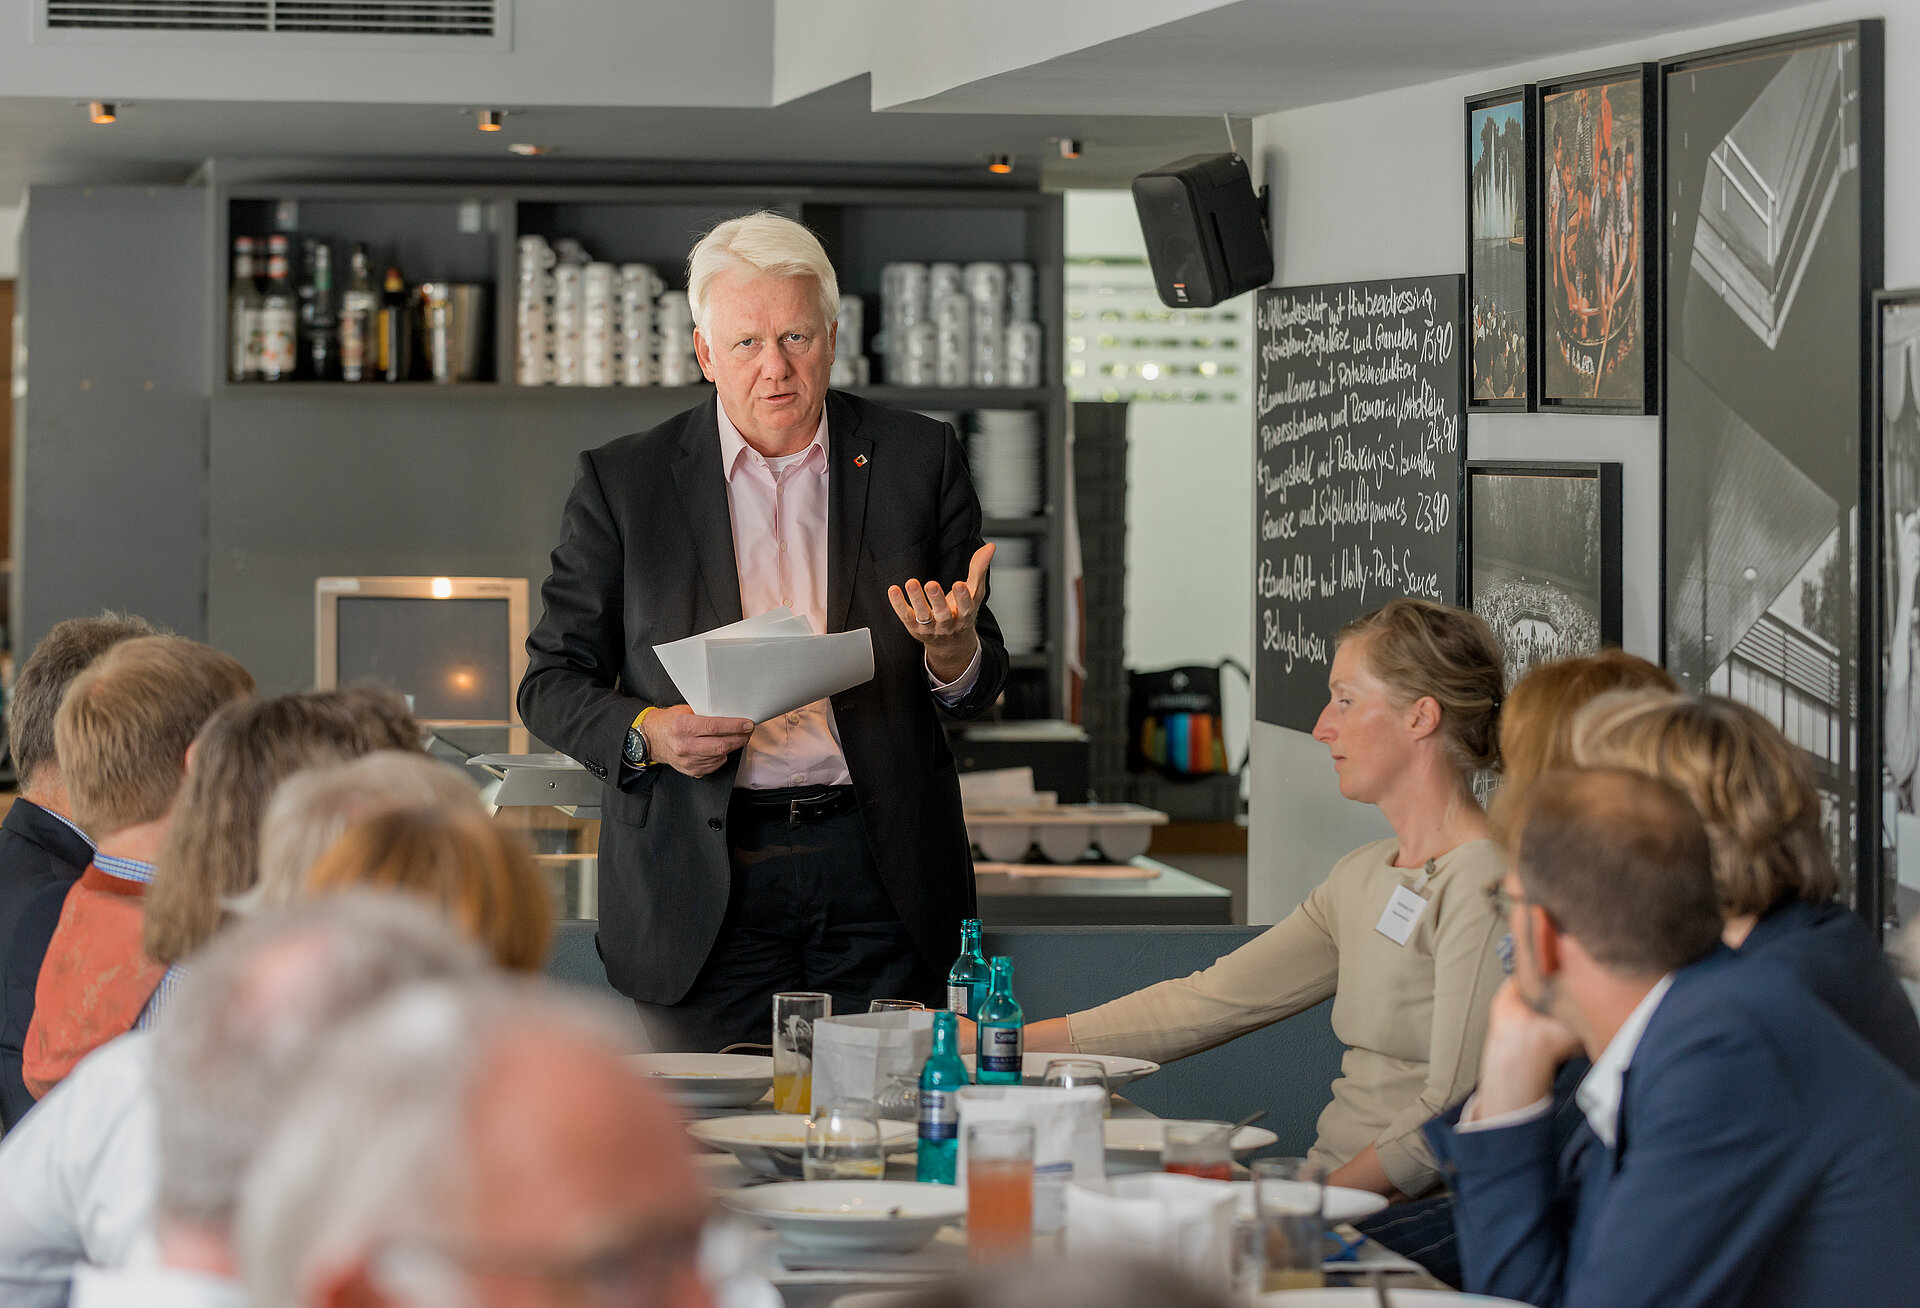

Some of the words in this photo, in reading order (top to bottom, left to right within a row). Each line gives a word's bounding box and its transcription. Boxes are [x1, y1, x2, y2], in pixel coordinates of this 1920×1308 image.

[1329, 292, 1346, 324] mit
[1353, 323, 1373, 354] und
[1420, 321, 1453, 366] 15,90
[1319, 360, 1336, 397] mit
[1331, 394, 1349, 430] und
[1318, 437, 1335, 478] mit
[1299, 488, 1317, 528] und
[1415, 491, 1450, 534] 23,90
[1320, 553, 1338, 598] mit
